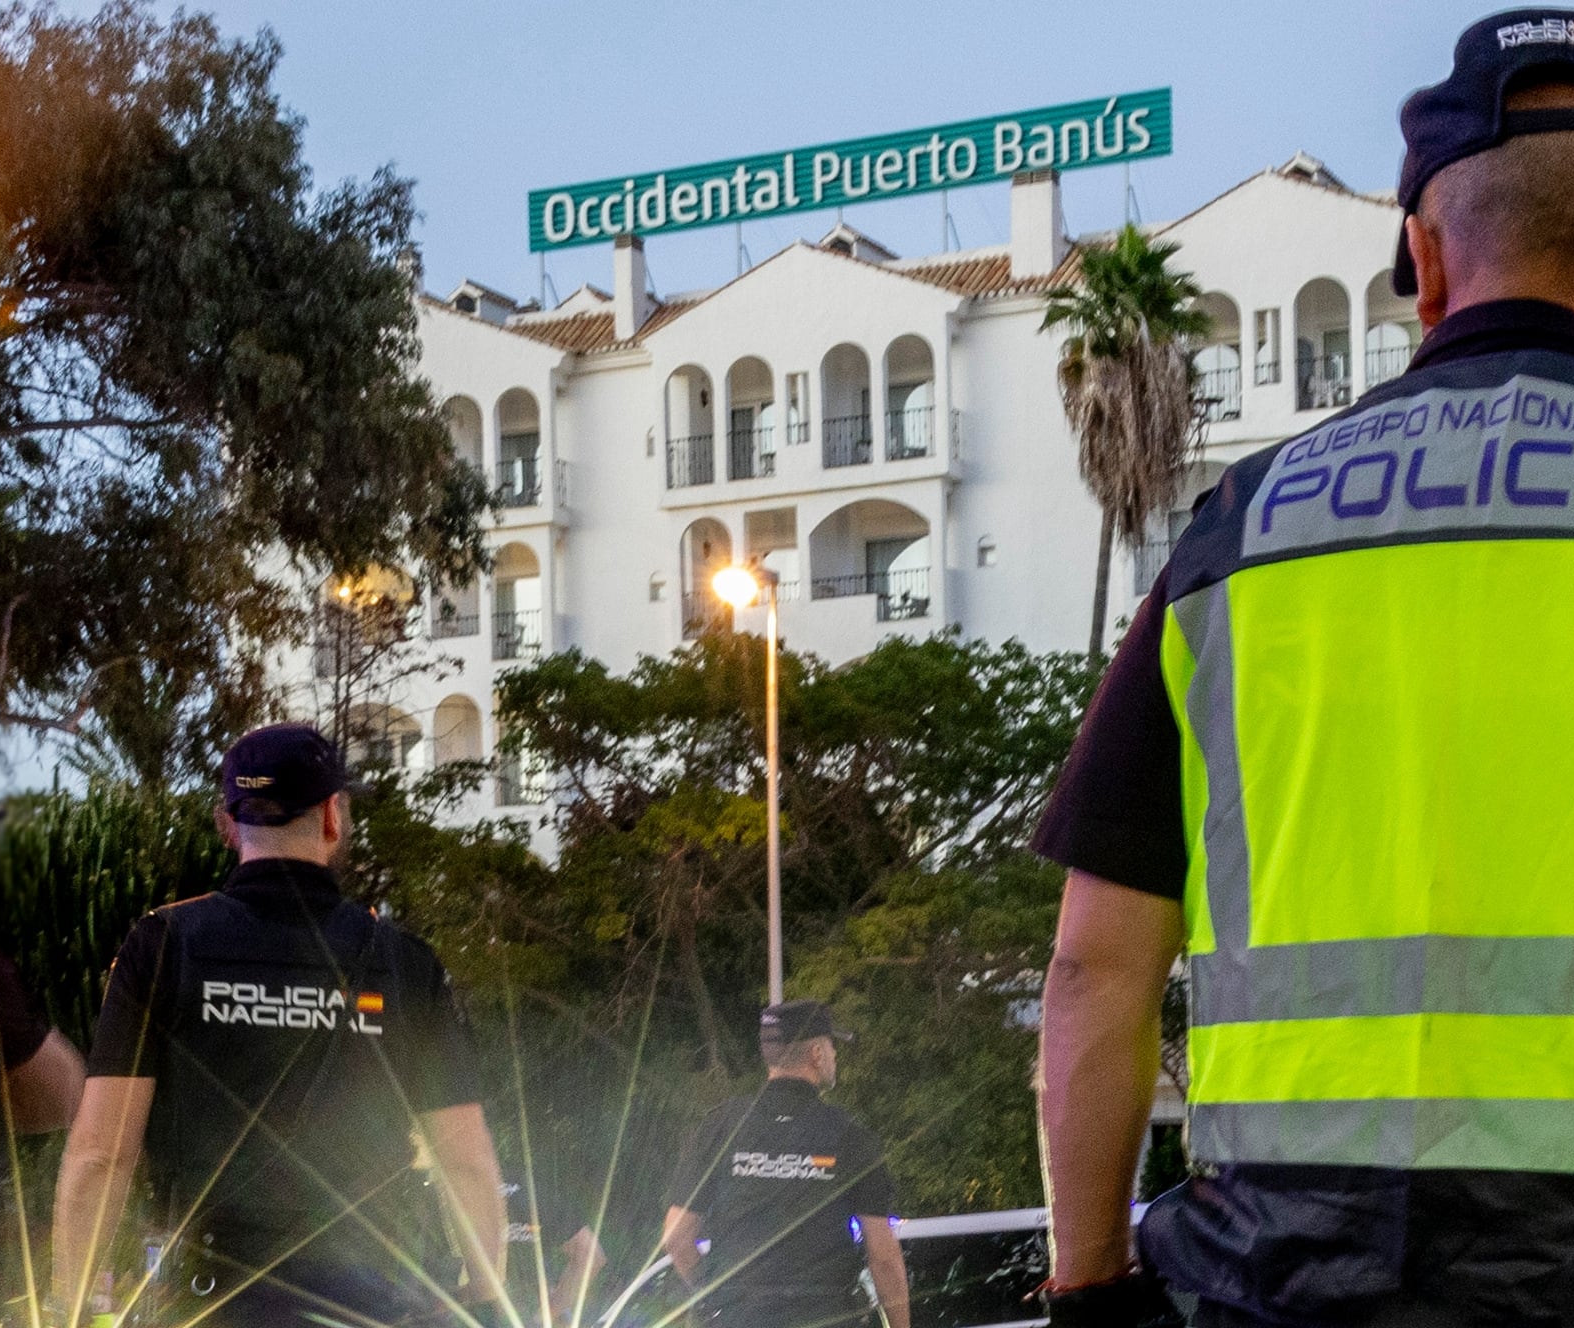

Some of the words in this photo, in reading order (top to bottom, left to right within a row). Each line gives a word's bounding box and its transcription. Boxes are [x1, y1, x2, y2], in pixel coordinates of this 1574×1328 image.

[542, 153, 800, 243] Occidental
[812, 132, 978, 198] Puerto
[992, 97, 1151, 170] Banús
[1282, 406, 1428, 467] CUERPO
[202, 981, 346, 1010] POLICIA
[732, 1151, 813, 1168] POLICIA
[732, 1164, 836, 1180] NACIONAL
